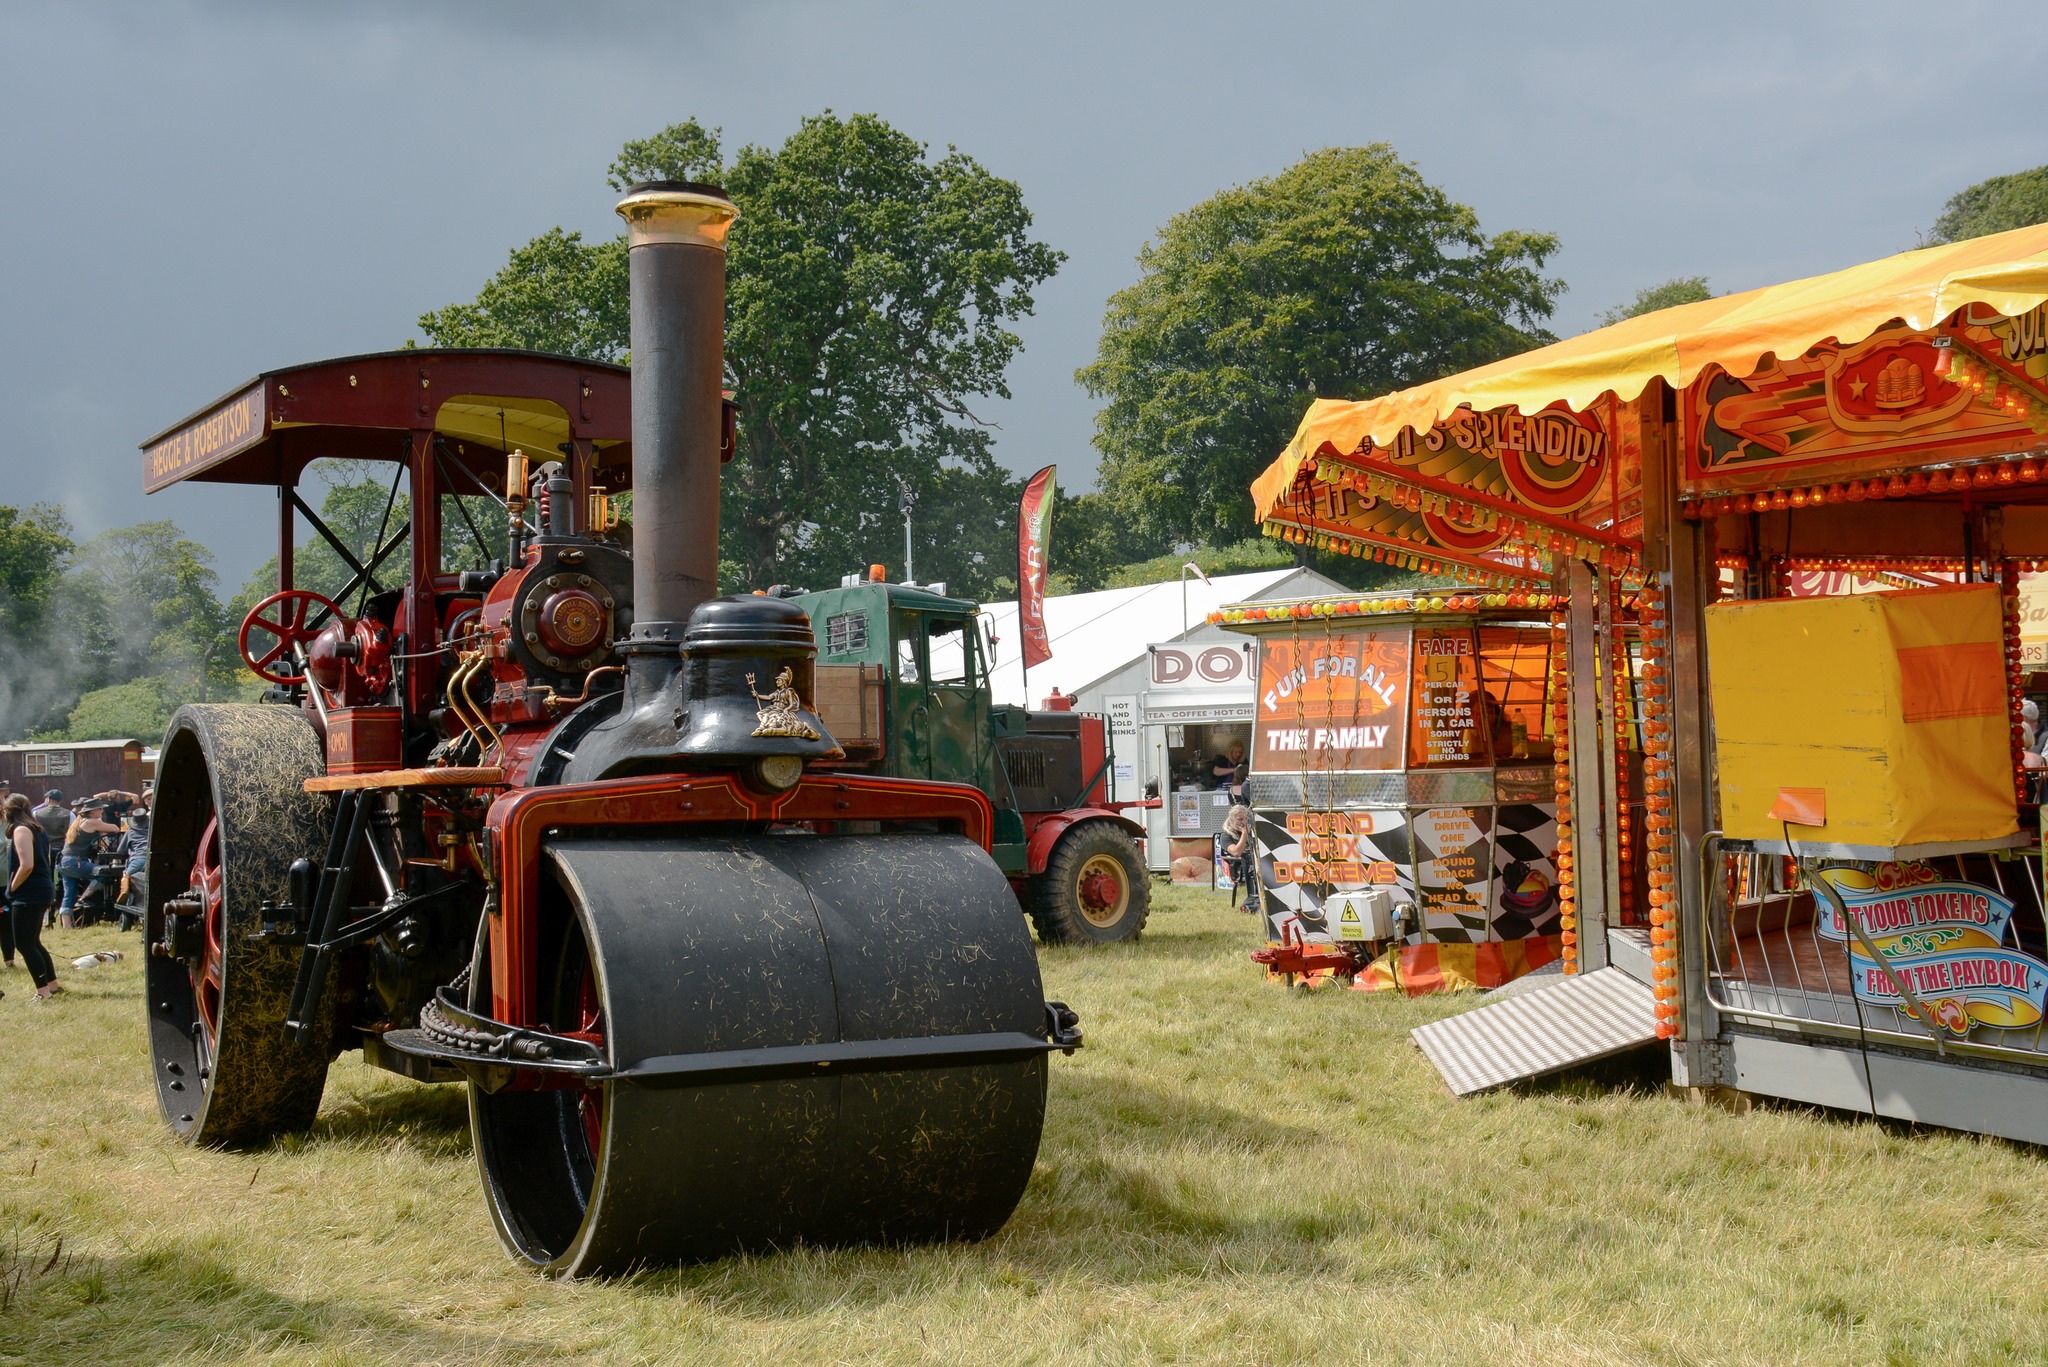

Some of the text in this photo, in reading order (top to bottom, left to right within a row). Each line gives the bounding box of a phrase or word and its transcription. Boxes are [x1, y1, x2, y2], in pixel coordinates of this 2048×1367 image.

[153, 398, 250, 479] HEGGIE & ROBERTSON
[1418, 638, 1469, 657] FARE
[1436, 661, 1448, 682] 5
[1263, 655, 1396, 712] FUN FOR ALL
[1425, 681, 1465, 689] PER CAR
[1420, 691, 1470, 704] 1 OR 2
[1172, 710, 1208, 718] COFFEE
[1214, 709, 1233, 717] HOT
[1417, 707, 1471, 717] PERSONS
[1419, 718, 1474, 728] IN A CAR
[1266, 725, 1391, 751] THE FAMILY
[1430, 730, 1461, 738] SORRY
[1426, 740, 1470, 748] STRICTLY
[1428, 753, 1470, 761] REFUNDS
[1429, 809, 1475, 819] PLEASE
[1286, 812, 1374, 835] GRAND
[1434, 821, 1470, 831] DRIVE
[1440, 833, 1465, 843] ONE
[1301, 837, 1362, 860] PRIX
[1440, 845, 1467, 855] WAY
[1432, 857, 1475, 867] ROUND
[1273, 861, 1397, 884] DODGEMS
[1434, 869, 1475, 879] TRACK
[1446, 881, 1464, 891] NO
[1428, 892, 1483, 903] HEAD ON
[1428, 904, 1483, 915] BUMPING
[1860, 898, 1911, 932] YOUR
[1911, 892, 1990, 926] TOKENS
[1866, 958, 2030, 996] FROM THE PAYBOX
